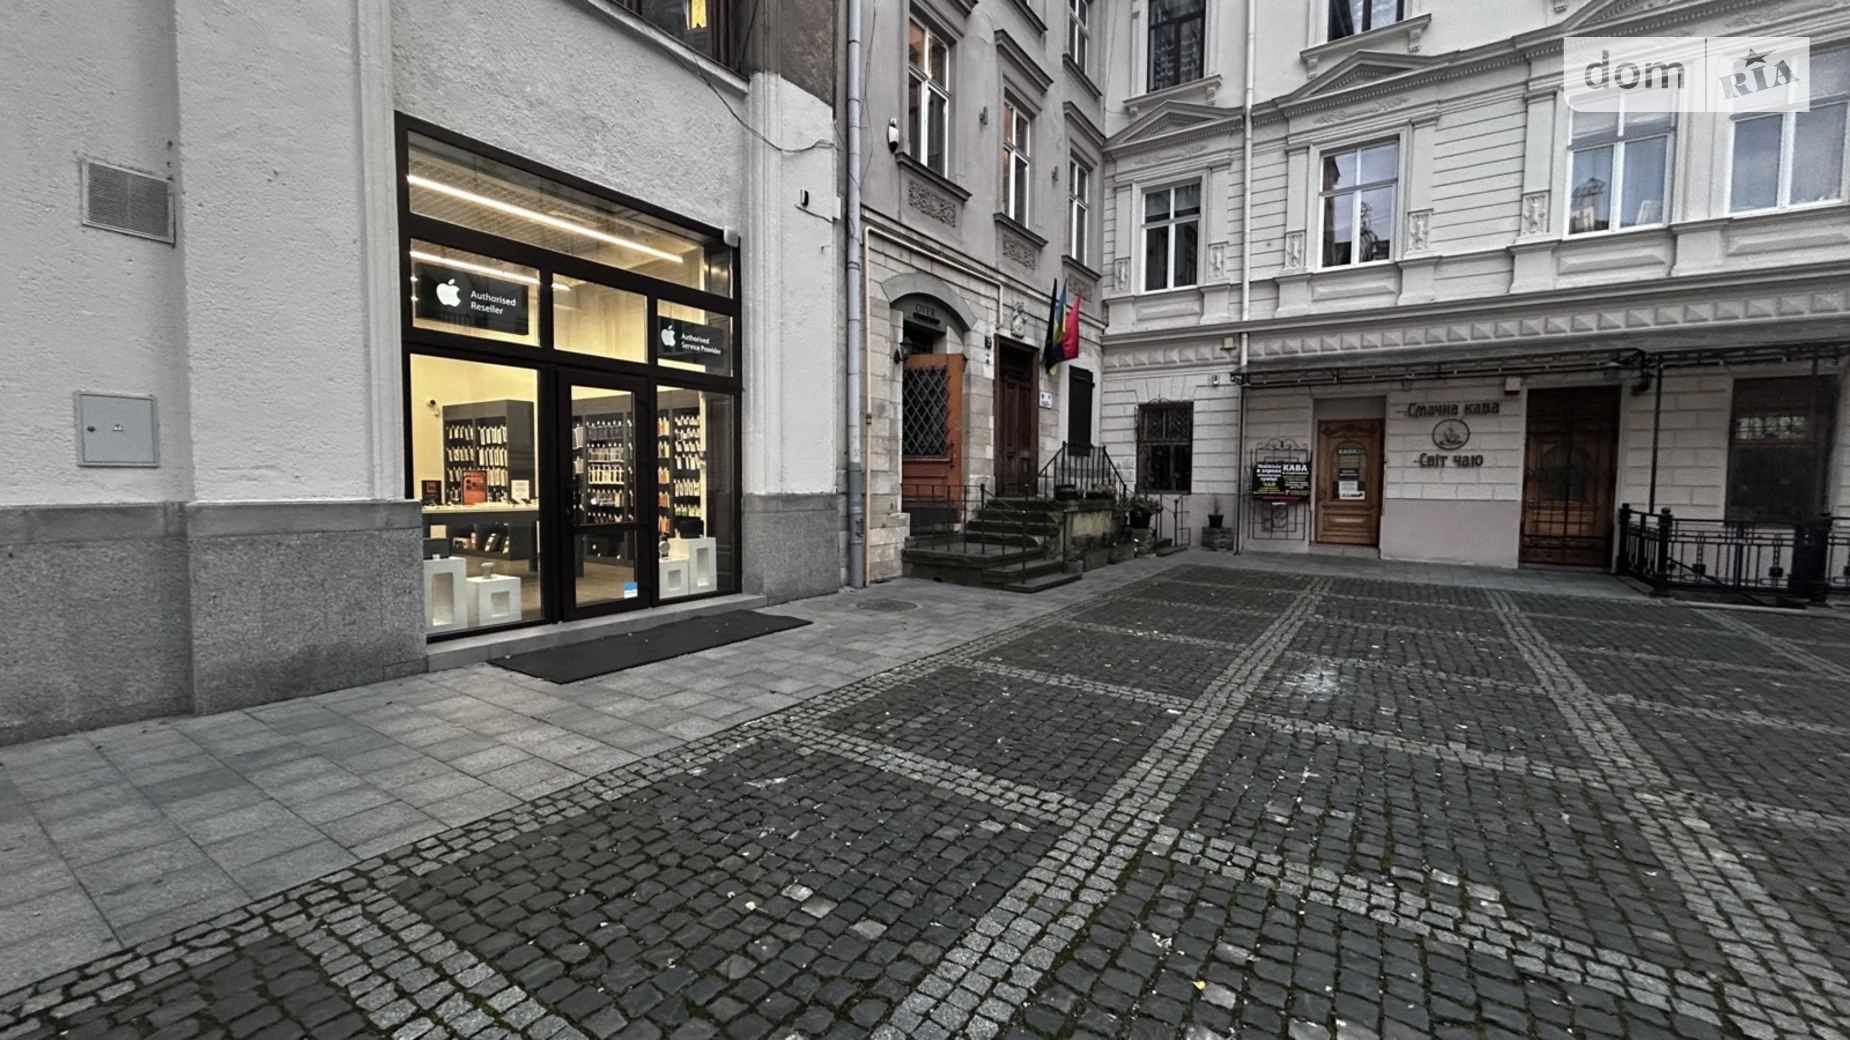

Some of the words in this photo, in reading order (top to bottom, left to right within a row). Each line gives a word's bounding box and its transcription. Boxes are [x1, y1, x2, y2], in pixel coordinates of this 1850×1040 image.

[470, 290, 517, 307] Authorised
[470, 301, 504, 315] Reseller
[681, 333, 710, 344] Authorised
[681, 341, 701, 352] Service
[700, 345, 722, 355] Provider
[1407, 402, 1459, 417] Смачна
[1464, 402, 1500, 415] кава
[1420, 452, 1448, 468] Світ
[1453, 454, 1484, 467] чаю
[1282, 464, 1308, 472] КАВА
